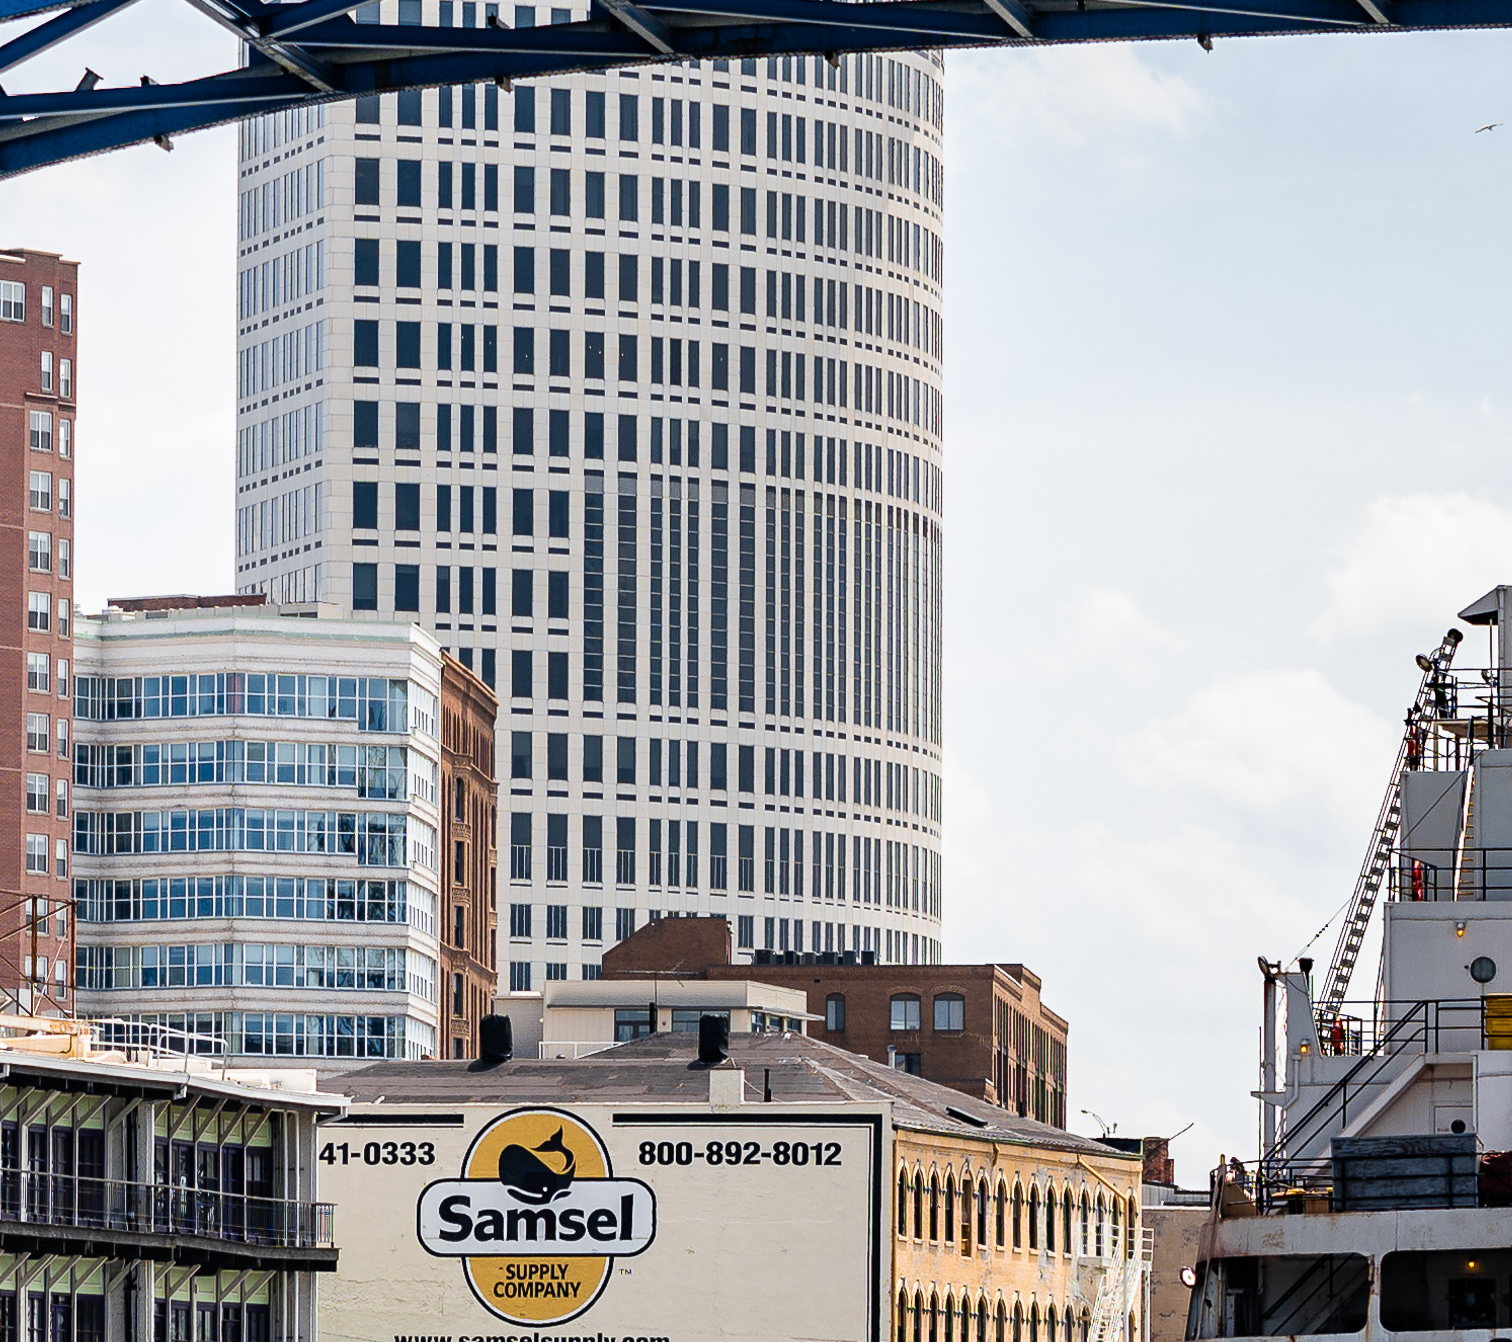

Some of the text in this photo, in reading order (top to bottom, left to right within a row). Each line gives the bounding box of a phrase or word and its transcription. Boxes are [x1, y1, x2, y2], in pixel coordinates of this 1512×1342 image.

[638, 1141, 843, 1167] 800-892-8012
[437, 1193, 635, 1244] Samsel
[505, 1263, 569, 1282] SUPPLY
[493, 1281, 582, 1300] COMPANY
